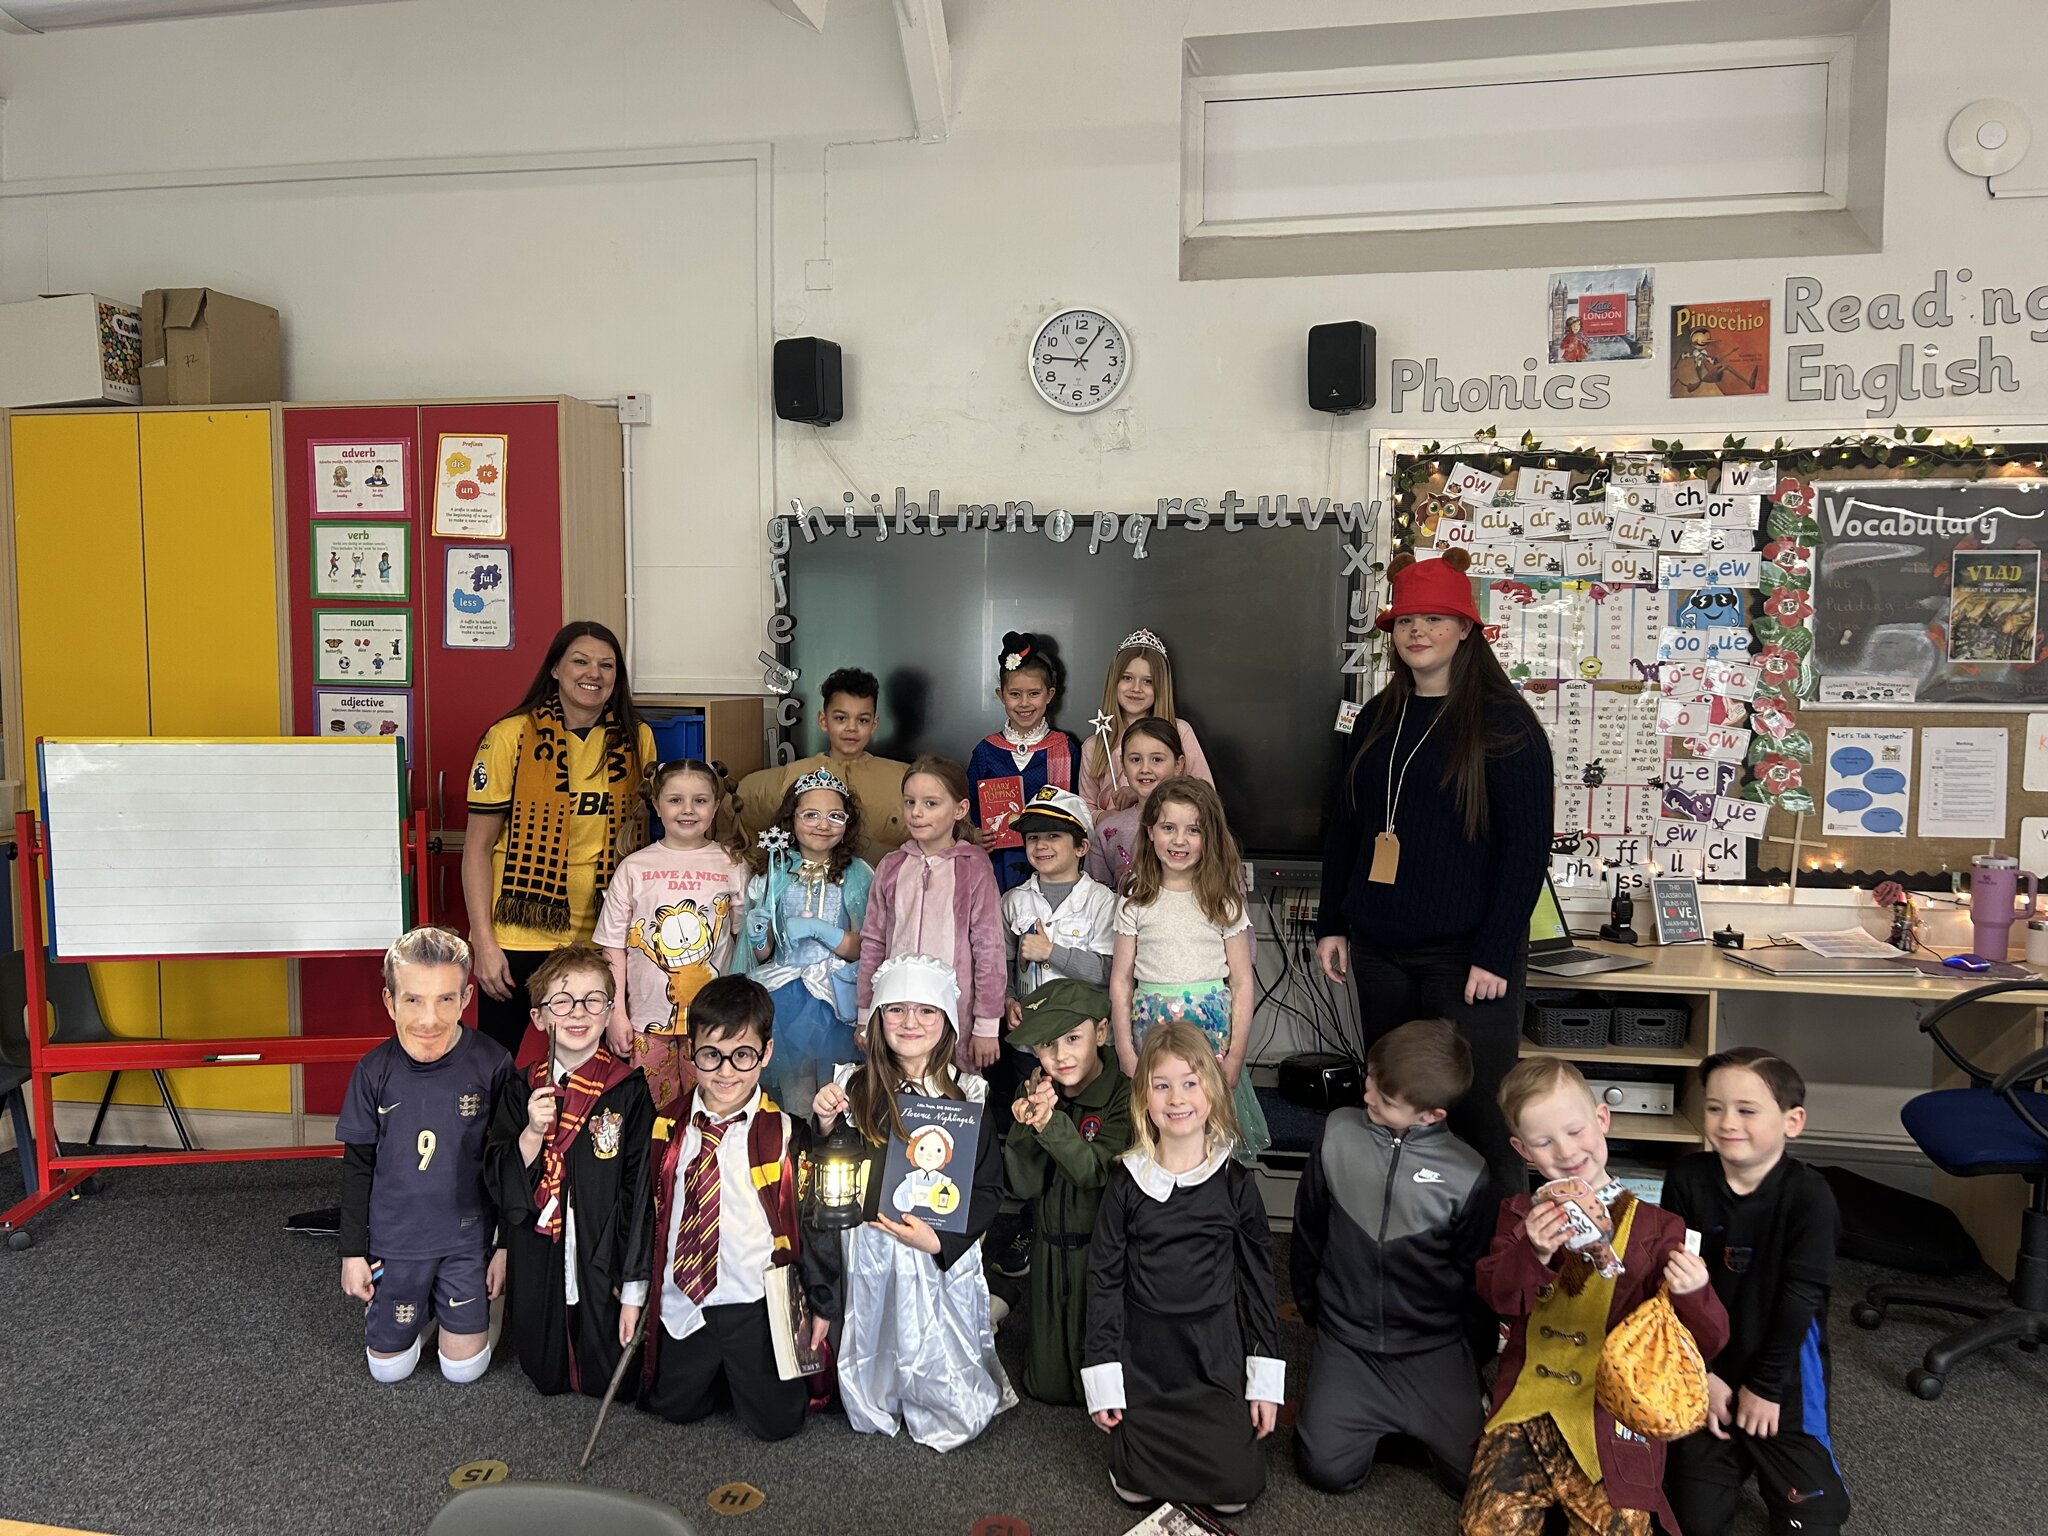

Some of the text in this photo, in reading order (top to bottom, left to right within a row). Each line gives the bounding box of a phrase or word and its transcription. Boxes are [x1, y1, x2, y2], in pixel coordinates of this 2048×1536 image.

[1785, 268, 2048, 343] Readng
[1583, 311, 1622, 320] LONDON
[1676, 307, 1764, 337] Pinocchio
[1062, 325, 1069, 335] 11
[1075, 319, 1089, 330] 12
[1047, 336, 1058, 347] 10
[1104, 339, 1114, 349] 2
[1042, 354, 1053, 364] 9
[1108, 355, 1118, 366] 3
[1045, 371, 1056, 382] 8
[1101, 373, 1111, 384] 4
[1787, 336, 2020, 419] English
[109, 383, 134, 394] REFILL
[1057, 383, 1067, 395] 7
[1089, 385, 1100, 396] 5
[1391, 358, 1611, 413] Phonics
[1072, 390, 1083, 401] 6
[341, 447, 376, 458] adverb
[451, 460, 465, 468] dis
[1462, 474, 1492, 494] ow
[1533, 474, 1553, 494] ir
[1480, 513, 1510, 529] au
[1529, 511, 1556, 527] ar
[1576, 510, 1607, 527] aw
[1824, 497, 1998, 544] Vocabulary
[347, 530, 370, 540] verb
[1449, 527, 1474, 543] ou
[1618, 520, 1652, 542] air
[1470, 551, 1508, 567] are
[1523, 552, 1549, 567] er
[1577, 546, 1597, 567] oi
[1611, 558, 1637, 580] oy
[1668, 562, 1706, 578] u-e
[1718, 561, 1751, 577] ew
[1967, 563, 2023, 582] VLAD
[479, 572, 493, 585] ful
[1540, 582, 1548, 590] E
[460, 598, 477, 607] less
[350, 619, 375, 627] noun
[1674, 636, 1700, 651] oo
[1718, 635, 1748, 651] ue
[1669, 666, 1705, 683] o-e
[1718, 670, 1746, 688] oa
[340, 696, 384, 709] adjective
[1677, 711, 1690, 726] o
[1708, 732, 1740, 749] ow
[1873, 732, 1904, 740] Together
[1670, 764, 1710, 781] u-e
[988, 782, 1010, 792] MARY
[983, 788, 1016, 803] POPPINS
[1727, 803, 1757, 822] ue
[1666, 825, 1698, 843] ew
[1616, 839, 1638, 864] ff
[1708, 837, 1739, 860] ck
[642, 870, 729, 883] HAVE A NICE
[1566, 859, 1594, 883] ph
[667, 880, 701, 890] DAY!
[1619, 873, 1643, 889] ss
[900, 1107, 976, 1128] Florence Nightingale
[417, 1129, 437, 1171] 9
[1418, 1167, 1441, 1180] NIKE
[462, 1467, 494, 1482] 15
[719, 1489, 750, 1506] 14
